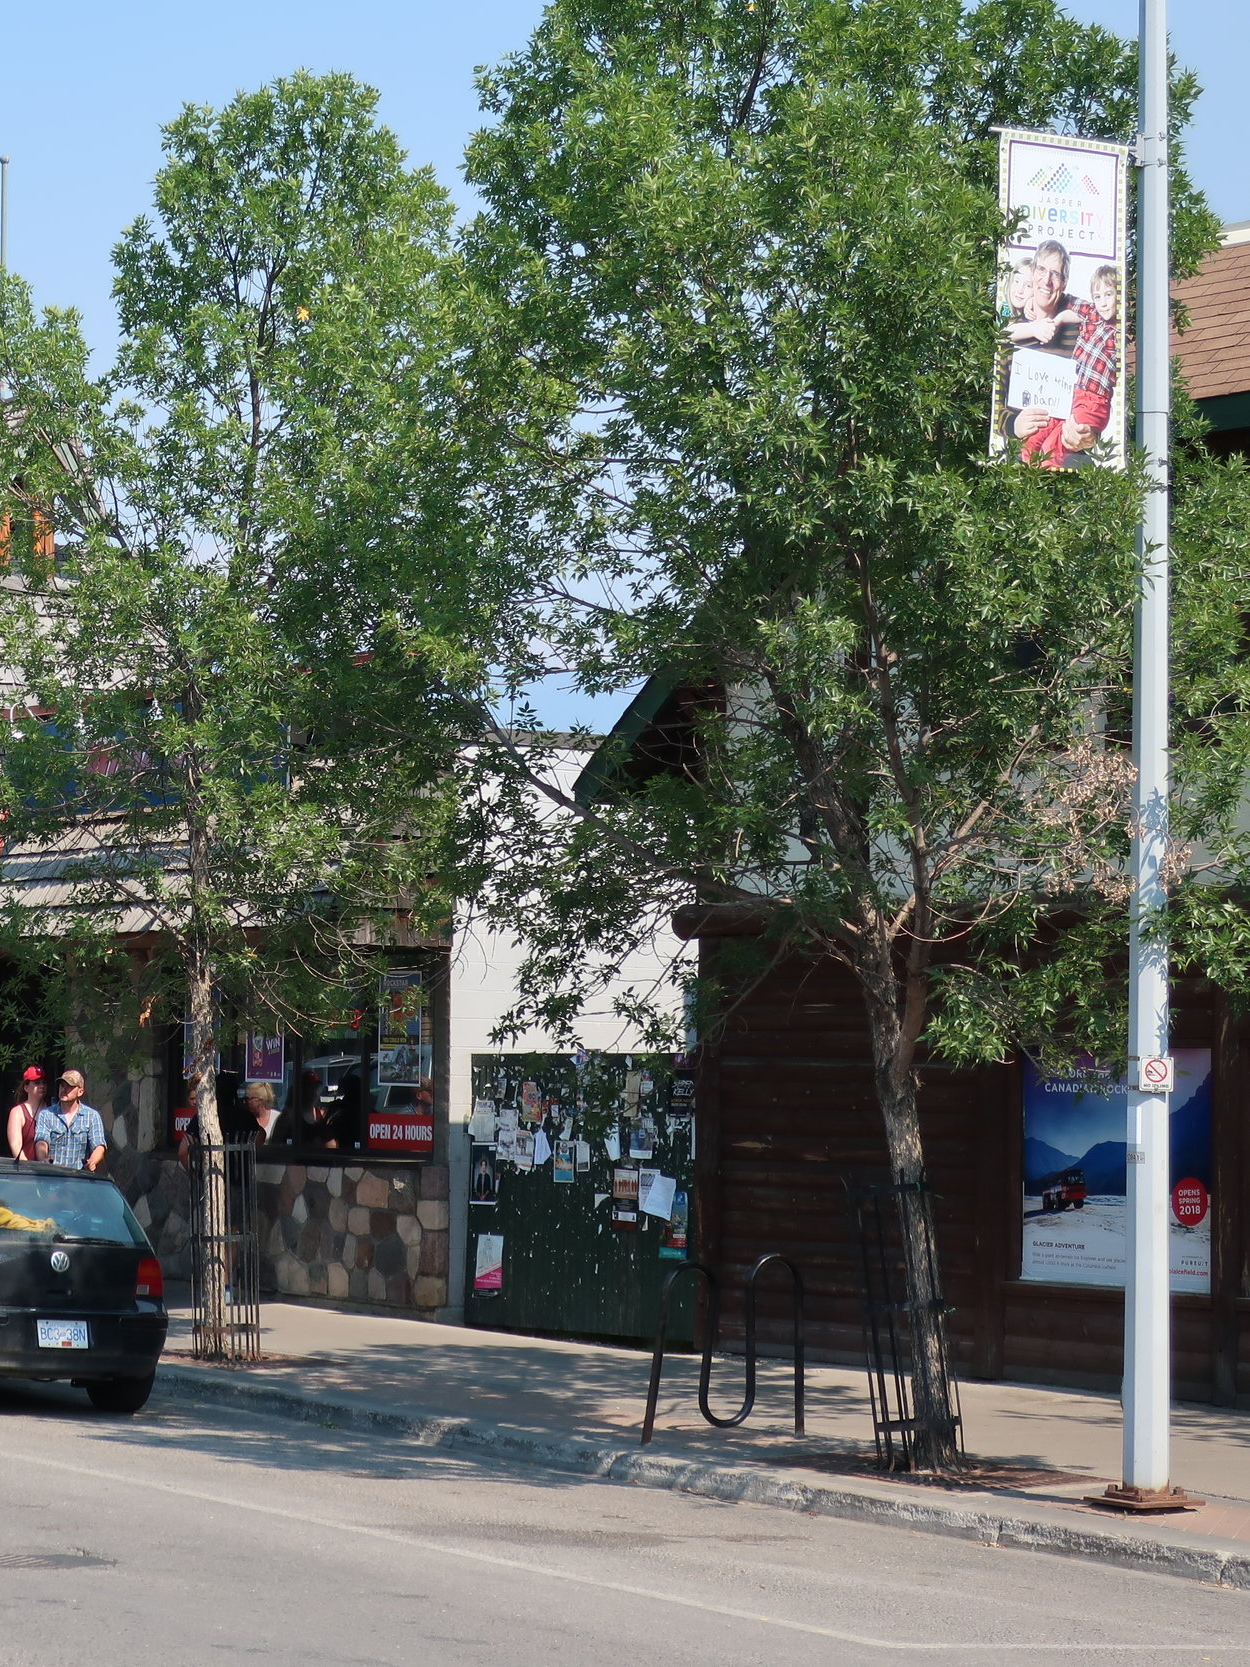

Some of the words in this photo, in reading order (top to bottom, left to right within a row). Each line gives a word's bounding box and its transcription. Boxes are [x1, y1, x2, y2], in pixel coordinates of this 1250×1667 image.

[1039, 195, 1082, 207] JASPER
[1028, 223, 1095, 240] PROJECT
[370, 1123, 391, 1139] OPEN
[392, 1125, 403, 1140] 24
[405, 1125, 433, 1141] HOURS
[1178, 1189, 1200, 1197] OPENS
[1178, 1197, 1201, 1205] SPRING
[1179, 1205, 1201, 1216] 2018
[1032, 1240, 1053, 1248] GLACIER
[1054, 1241, 1086, 1250] ADVENTURE
